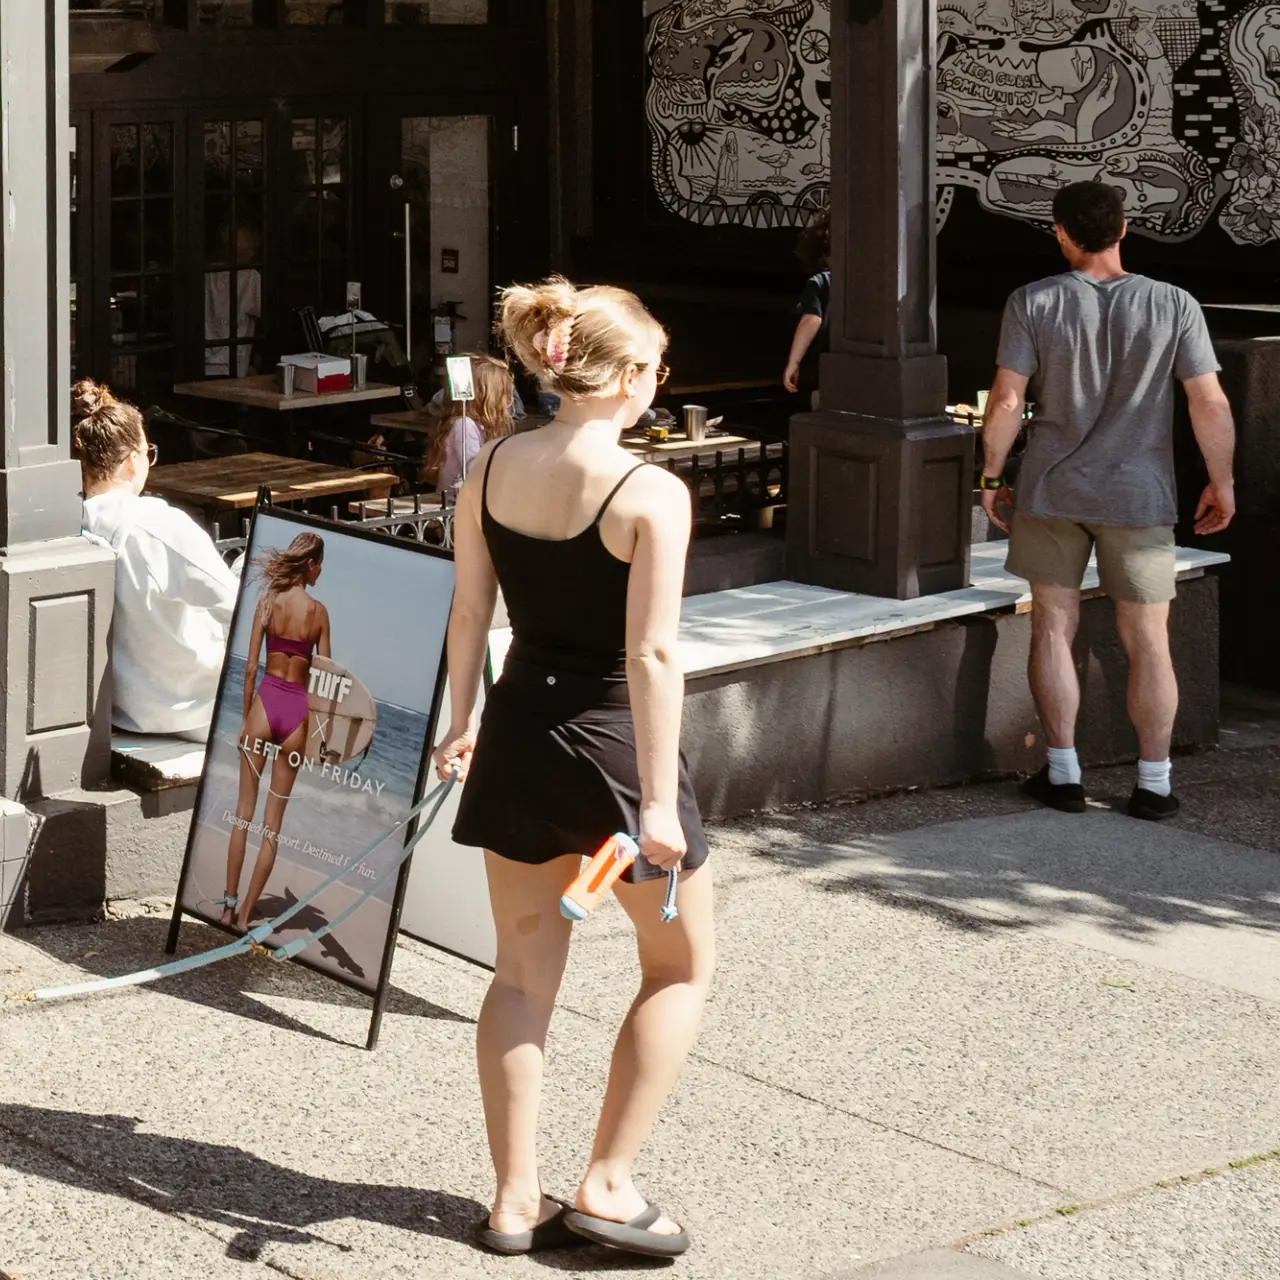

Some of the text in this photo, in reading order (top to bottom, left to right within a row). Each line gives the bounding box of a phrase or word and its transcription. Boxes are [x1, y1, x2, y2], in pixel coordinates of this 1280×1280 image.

[942, 68, 1038, 108] COMMUNITY
[952, 51, 994, 84] MEGA
[242, 735, 386, 797] LEFT ON FRIDAY
[221, 809, 376, 880] Designed for sport. Destined fr fun.
